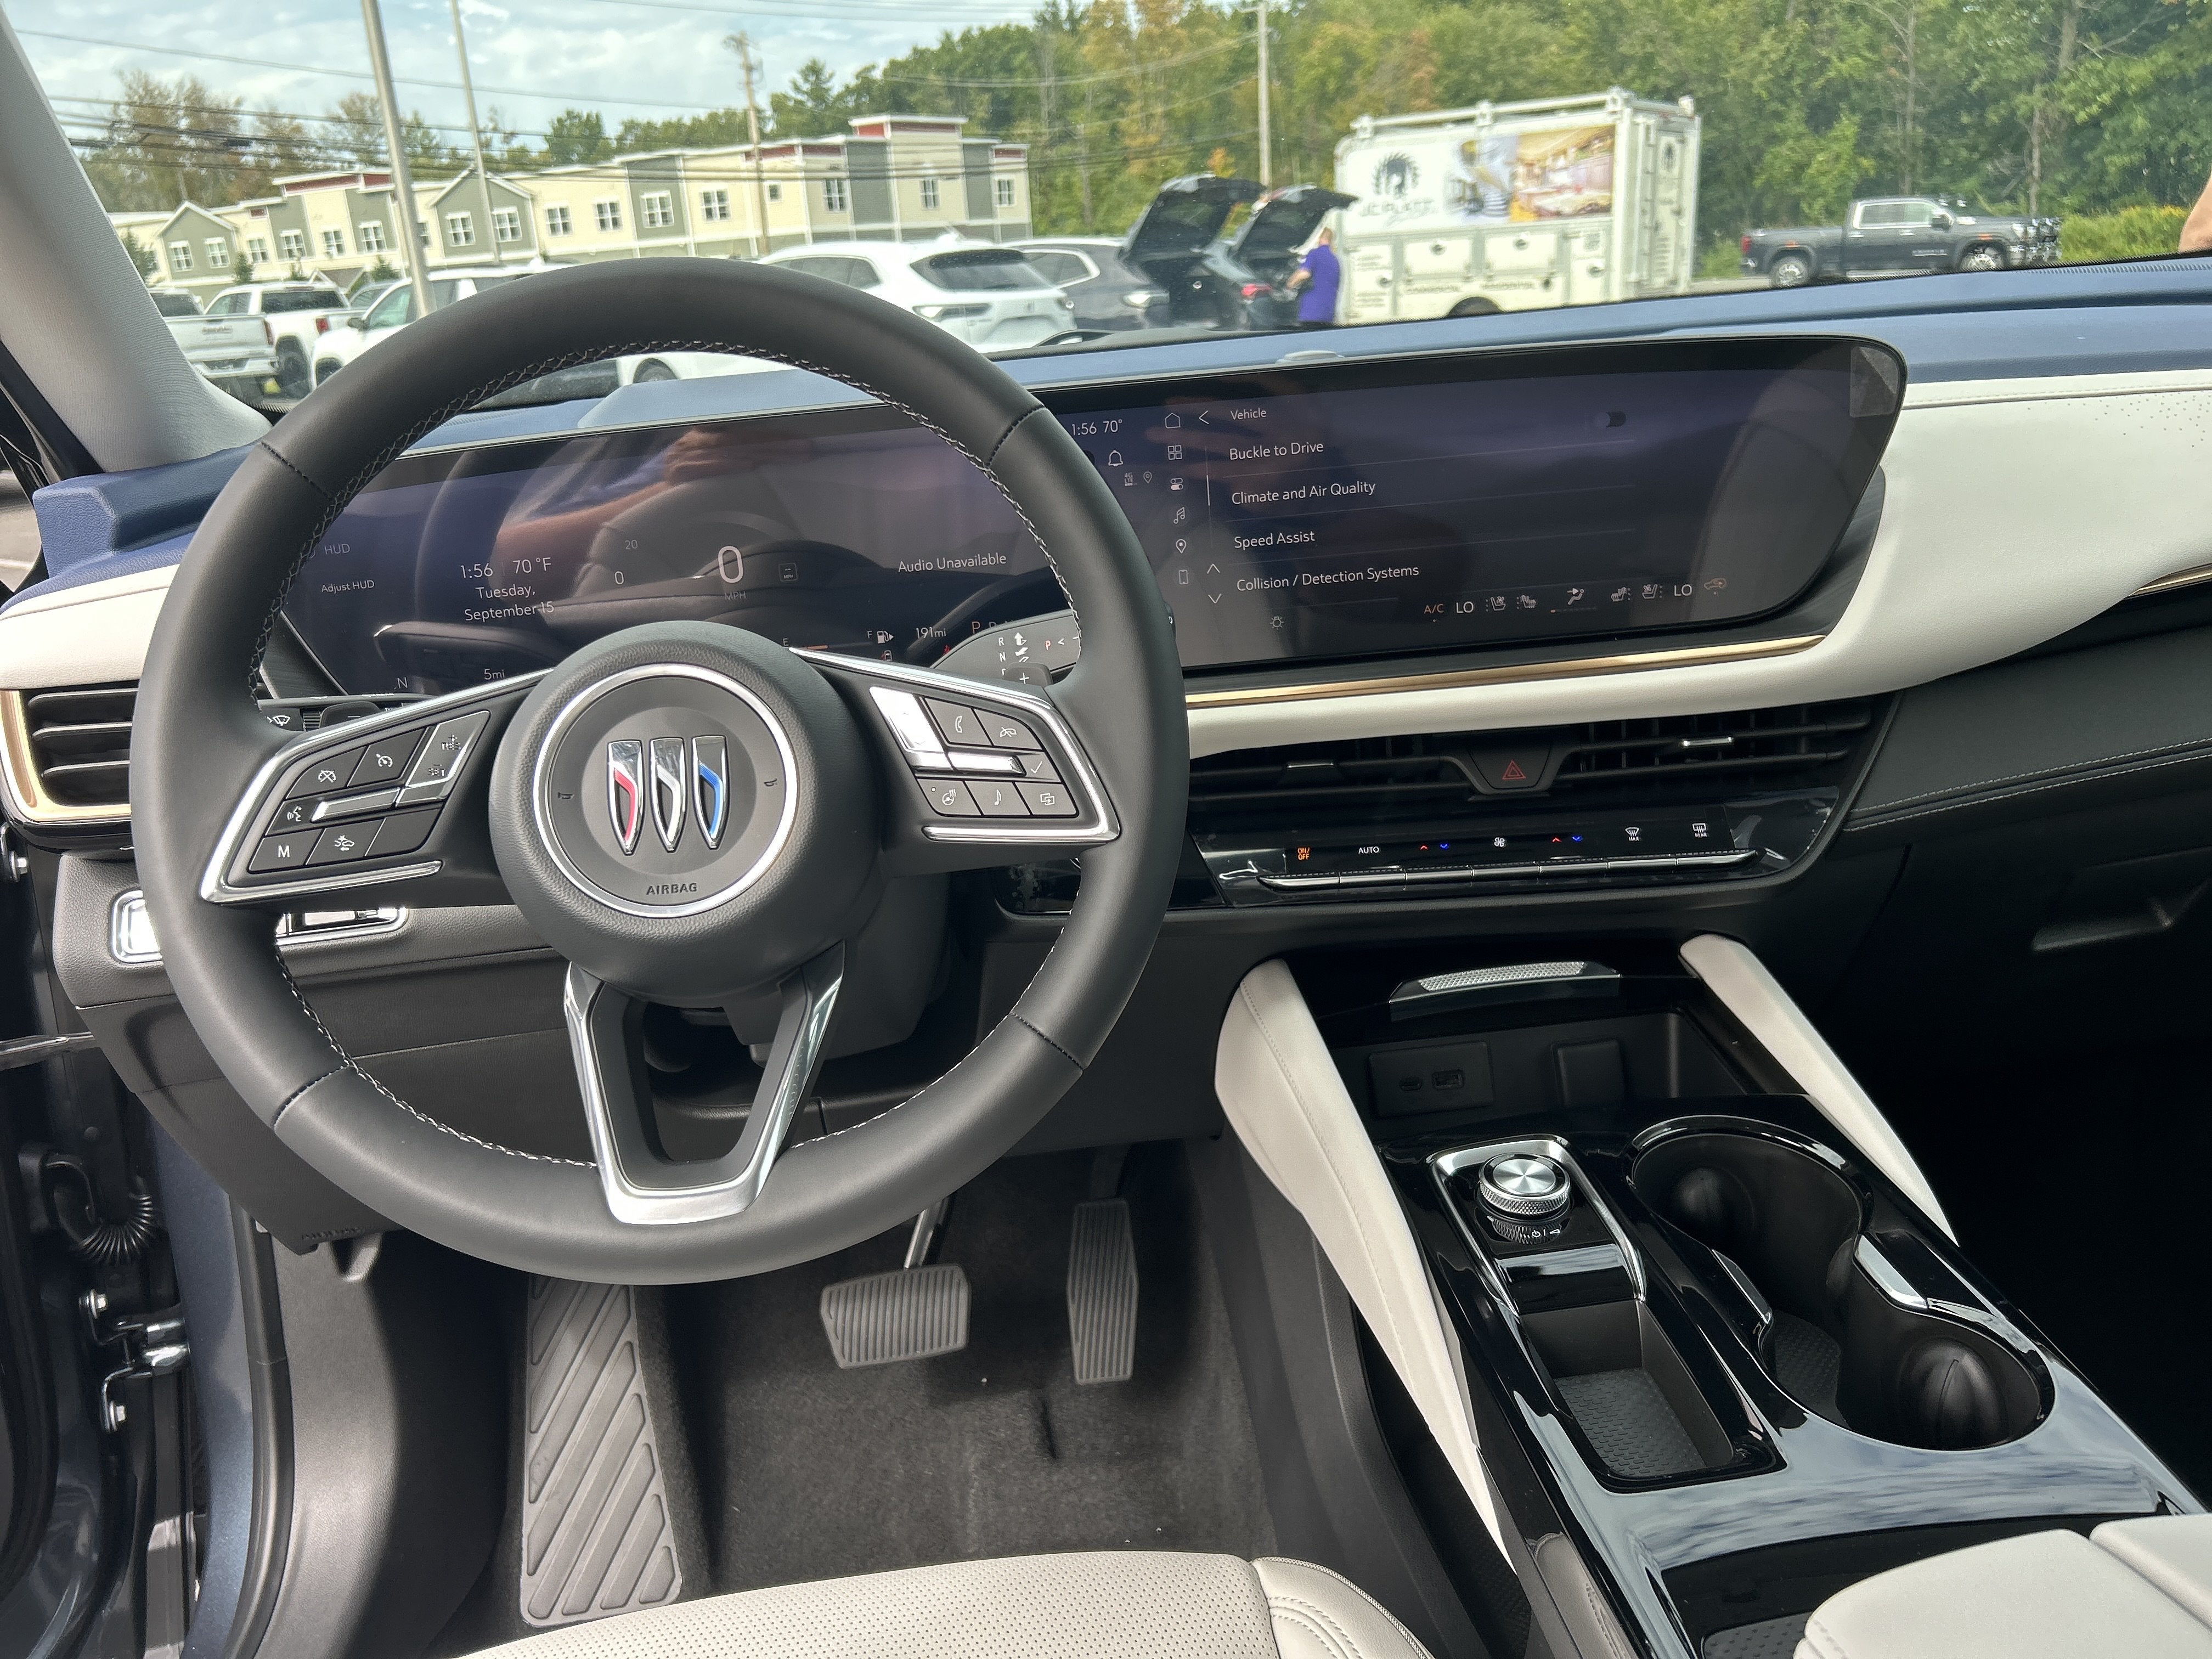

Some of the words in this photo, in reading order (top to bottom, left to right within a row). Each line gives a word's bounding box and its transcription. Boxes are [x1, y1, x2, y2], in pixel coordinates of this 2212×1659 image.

[1231, 408, 1267, 420] Vehicle
[1071, 422, 1097, 436] 1:56
[1103, 419, 1122, 433] 70°
[1229, 445, 1270, 460] Buckle
[1273, 445, 1287, 456] to
[1291, 442, 1324, 454] Drive
[1232, 491, 1279, 504] Climate
[1283, 486, 1306, 500] and
[1309, 485, 1327, 498] Air
[1330, 481, 1375, 495] Quality
[624, 539, 638, 550] 20
[1234, 533, 1273, 550] Speed
[1277, 531, 1315, 544] Assist
[324, 544, 350, 555] HUD
[460, 562, 493, 579] 1:56
[512, 558, 532, 574] 70
[718, 545, 744, 583] 0
[898, 558, 933, 573] Audio
[936, 552, 1007, 569] Unavailable
[614, 571, 624, 585] 0
[1237, 578, 1289, 591] Collision
[1293, 574, 1299, 586] /
[1302, 570, 1363, 585] Detection
[1367, 566, 1419, 582] Systems
[321, 583, 351, 594] Adjust
[352, 580, 375, 590] HUD
[475, 583, 535, 599] Tuesday,
[1674, 584, 1692, 597] LO
[724, 591, 747, 601] MPH
[465, 604, 537, 622] September
[540, 601, 554, 613] 15
[1424, 603, 1444, 614] A/C
[1456, 601, 1474, 613] LO
[916, 627, 947, 639] 191mi
[972, 621, 981, 634] P
[867, 630, 873, 639] F
[782, 637, 789, 647] E
[998, 637, 1005, 646] R
[1045, 640, 1051, 651] P
[999, 651, 1006, 662] N
[484, 668, 505, 680] 5mi
[397, 676, 408, 689] N
[278, 845, 290, 857] M
[1358, 846, 1380, 854] AUTO
[646, 882, 697, 895] AIRBAG
